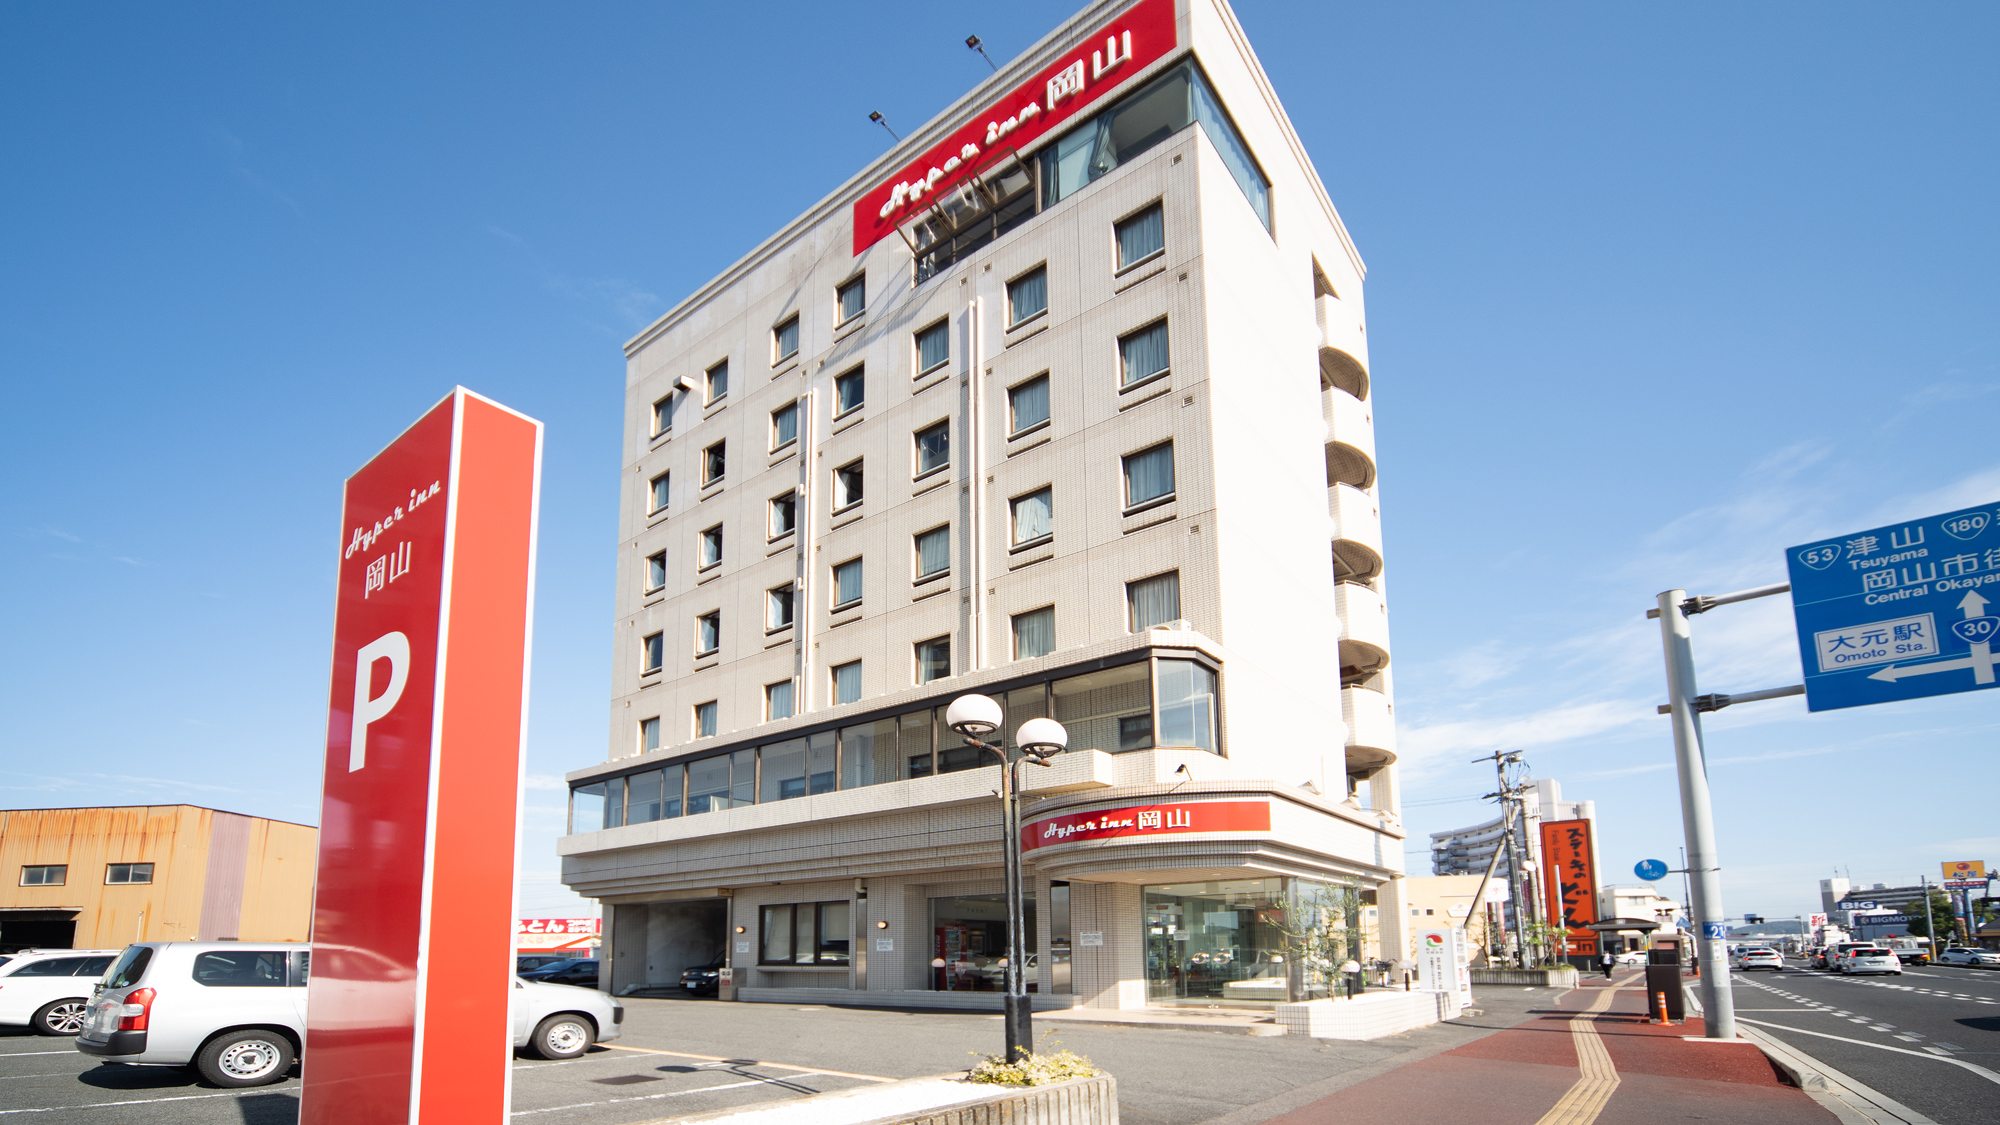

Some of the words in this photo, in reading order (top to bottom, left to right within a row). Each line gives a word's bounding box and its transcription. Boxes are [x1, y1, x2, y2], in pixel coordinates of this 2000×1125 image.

[879, 142, 980, 219] Hyper
[985, 101, 1041, 146] inn
[1047, 29, 1132, 111] 岡山
[344, 506, 404, 560] Hyper
[407, 480, 441, 512] inn
[1950, 516, 1985, 534] 180
[1807, 548, 1834, 564] 53
[1846, 526, 1925, 559] 津山
[364, 541, 411, 600] 岡山
[1849, 548, 1929, 571] Tsuyama
[1864, 585, 1929, 606] Central
[1935, 572, 2000, 592] Okaya
[1828, 622, 1925, 653] 大元駅
[1963, 621, 1991, 636] 30
[1834, 648, 1887, 664] Omoto
[1895, 642, 1928, 655] Sta.
[348, 631, 410, 773] P
[1044, 820, 1097, 839] Hyper
[1100, 816, 1134, 829] inn
[1138, 808, 1191, 830] 岡山
